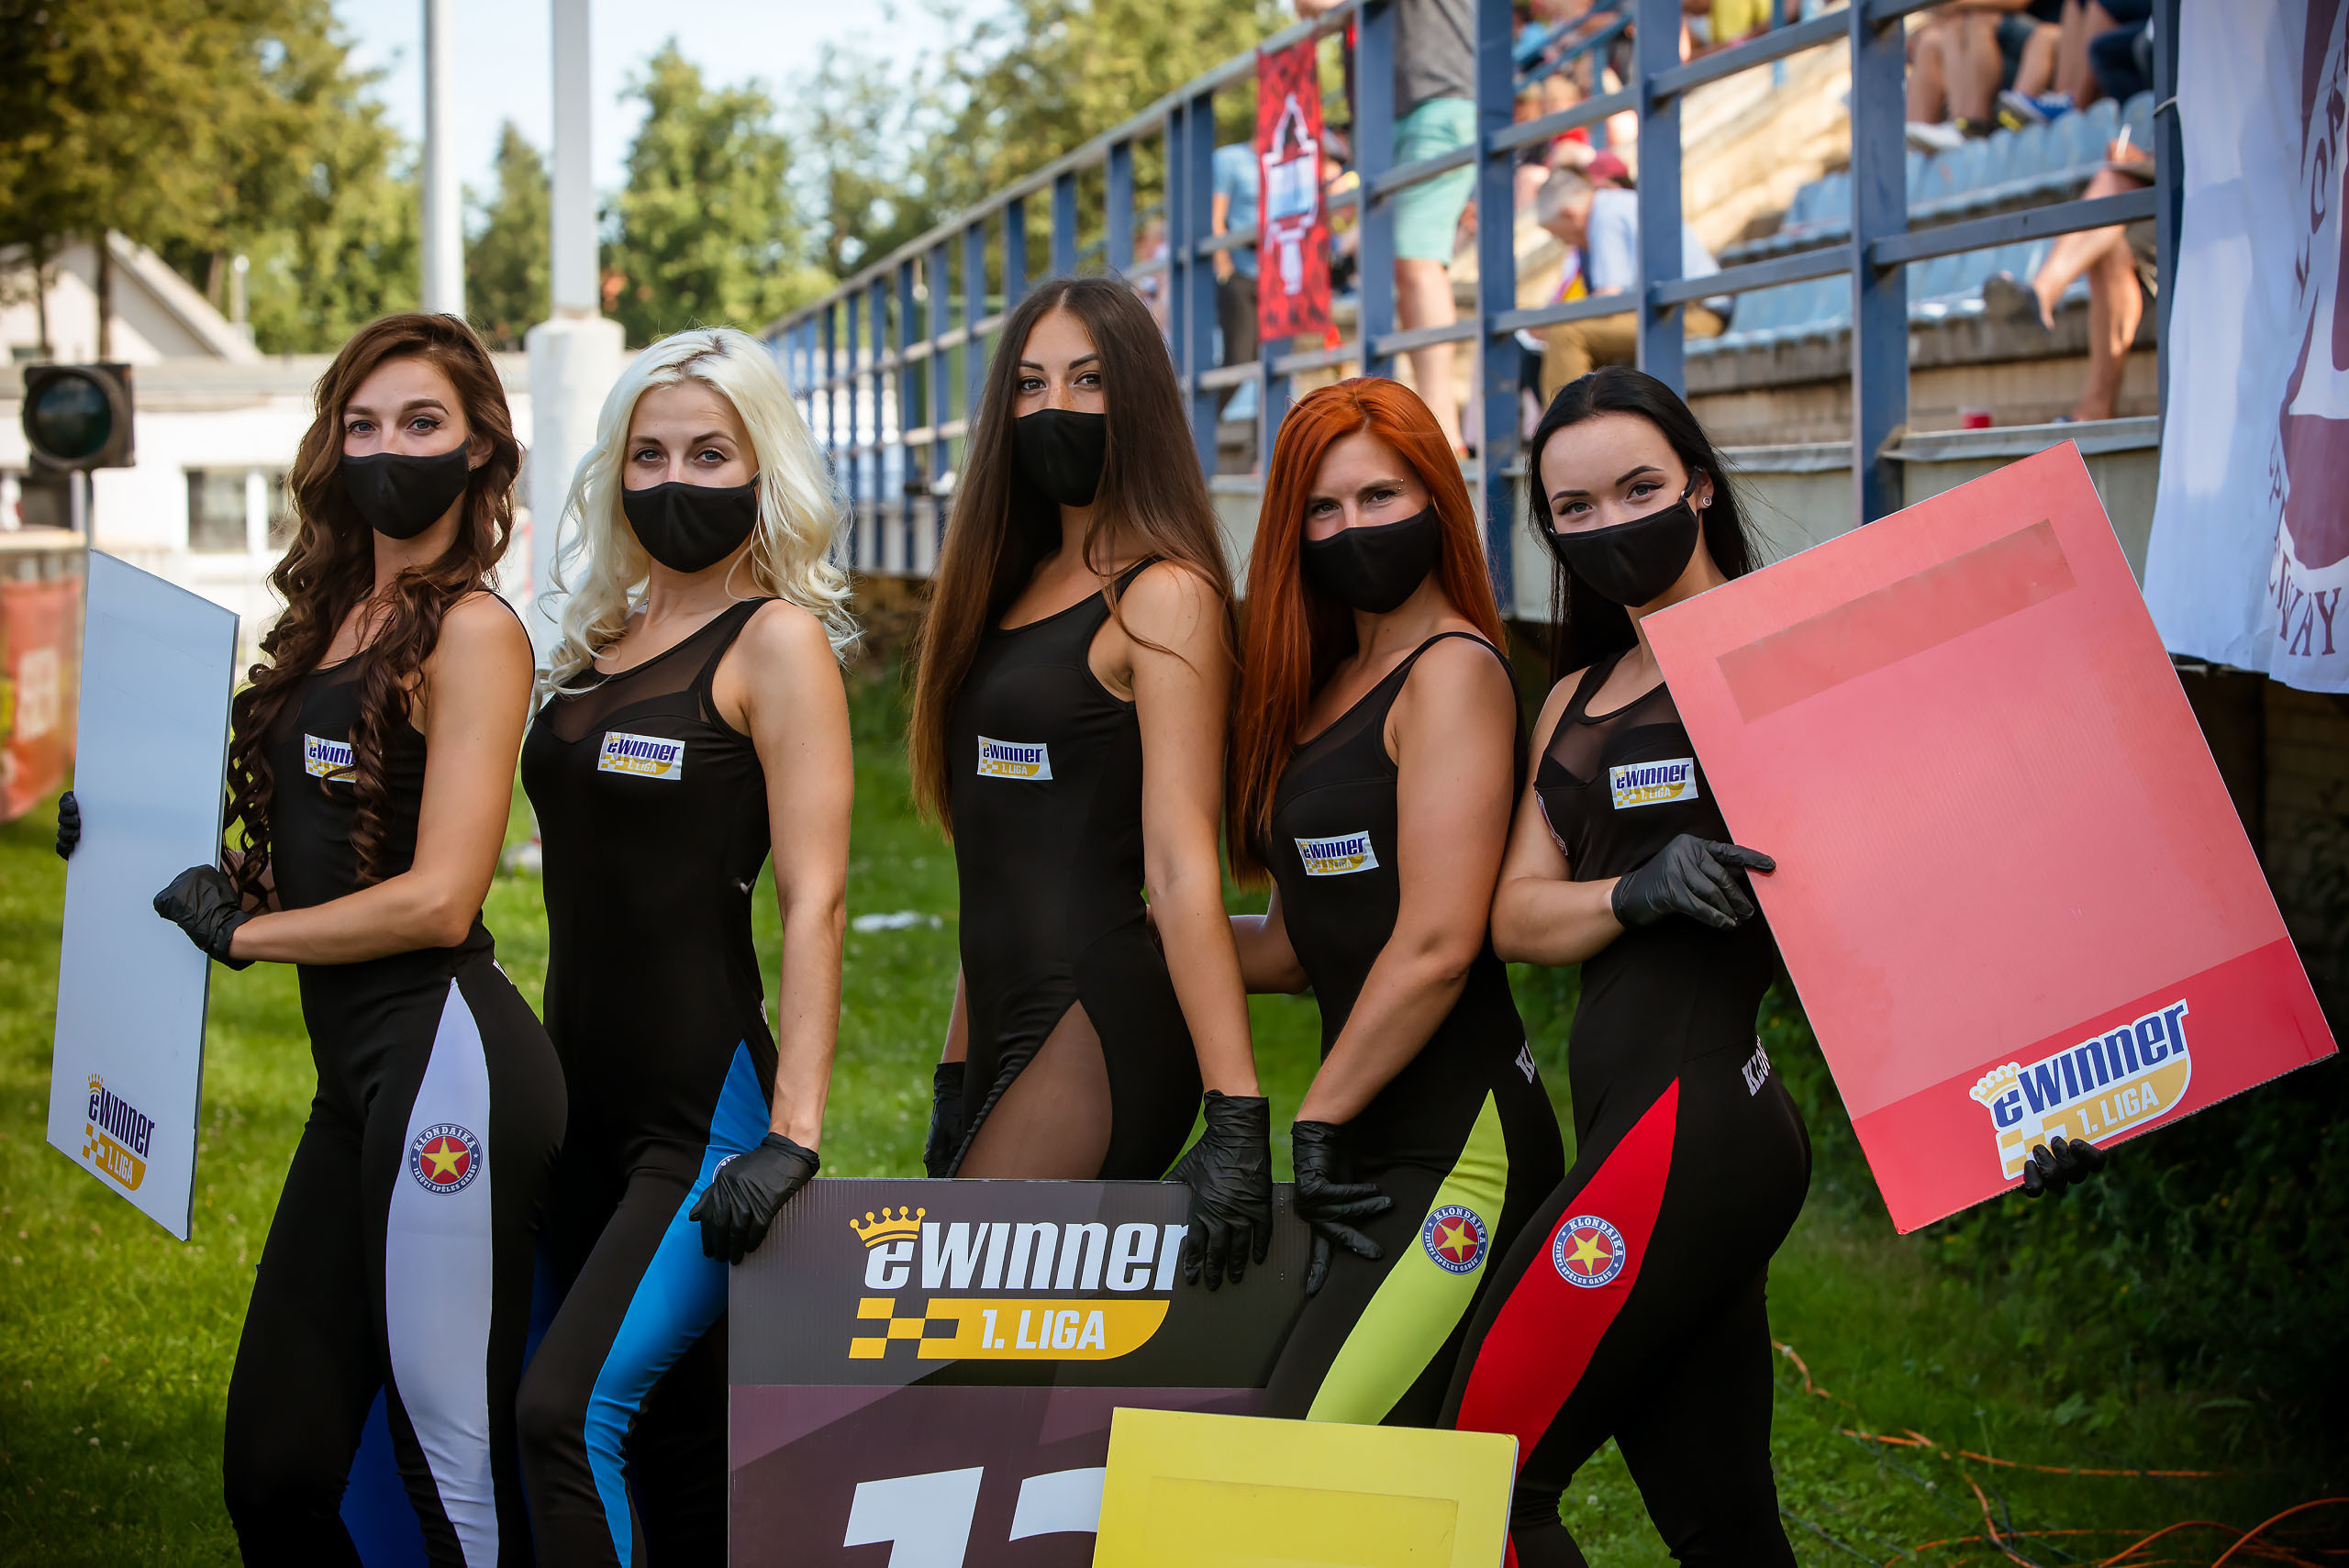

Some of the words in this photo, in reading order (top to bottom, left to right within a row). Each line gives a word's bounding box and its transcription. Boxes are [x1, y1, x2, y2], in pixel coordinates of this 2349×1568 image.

[635, 762, 657, 773] LIGA
[1008, 764, 1028, 775] LIGA
[1649, 787, 1672, 799] LIGA
[1333, 860, 1353, 870] LIGA
[2076, 1107, 2099, 1136] 1.
[2100, 1081, 2160, 1127] LIGA
[414, 1126, 476, 1151] KLONDAIKA
[114, 1151, 134, 1185] LIGA
[1433, 1207, 1486, 1243] KLONDAIKA
[1569, 1218, 1623, 1257] KLONDAIKA
[981, 1309, 1006, 1351] 1.
[1016, 1309, 1107, 1351] LIGA
